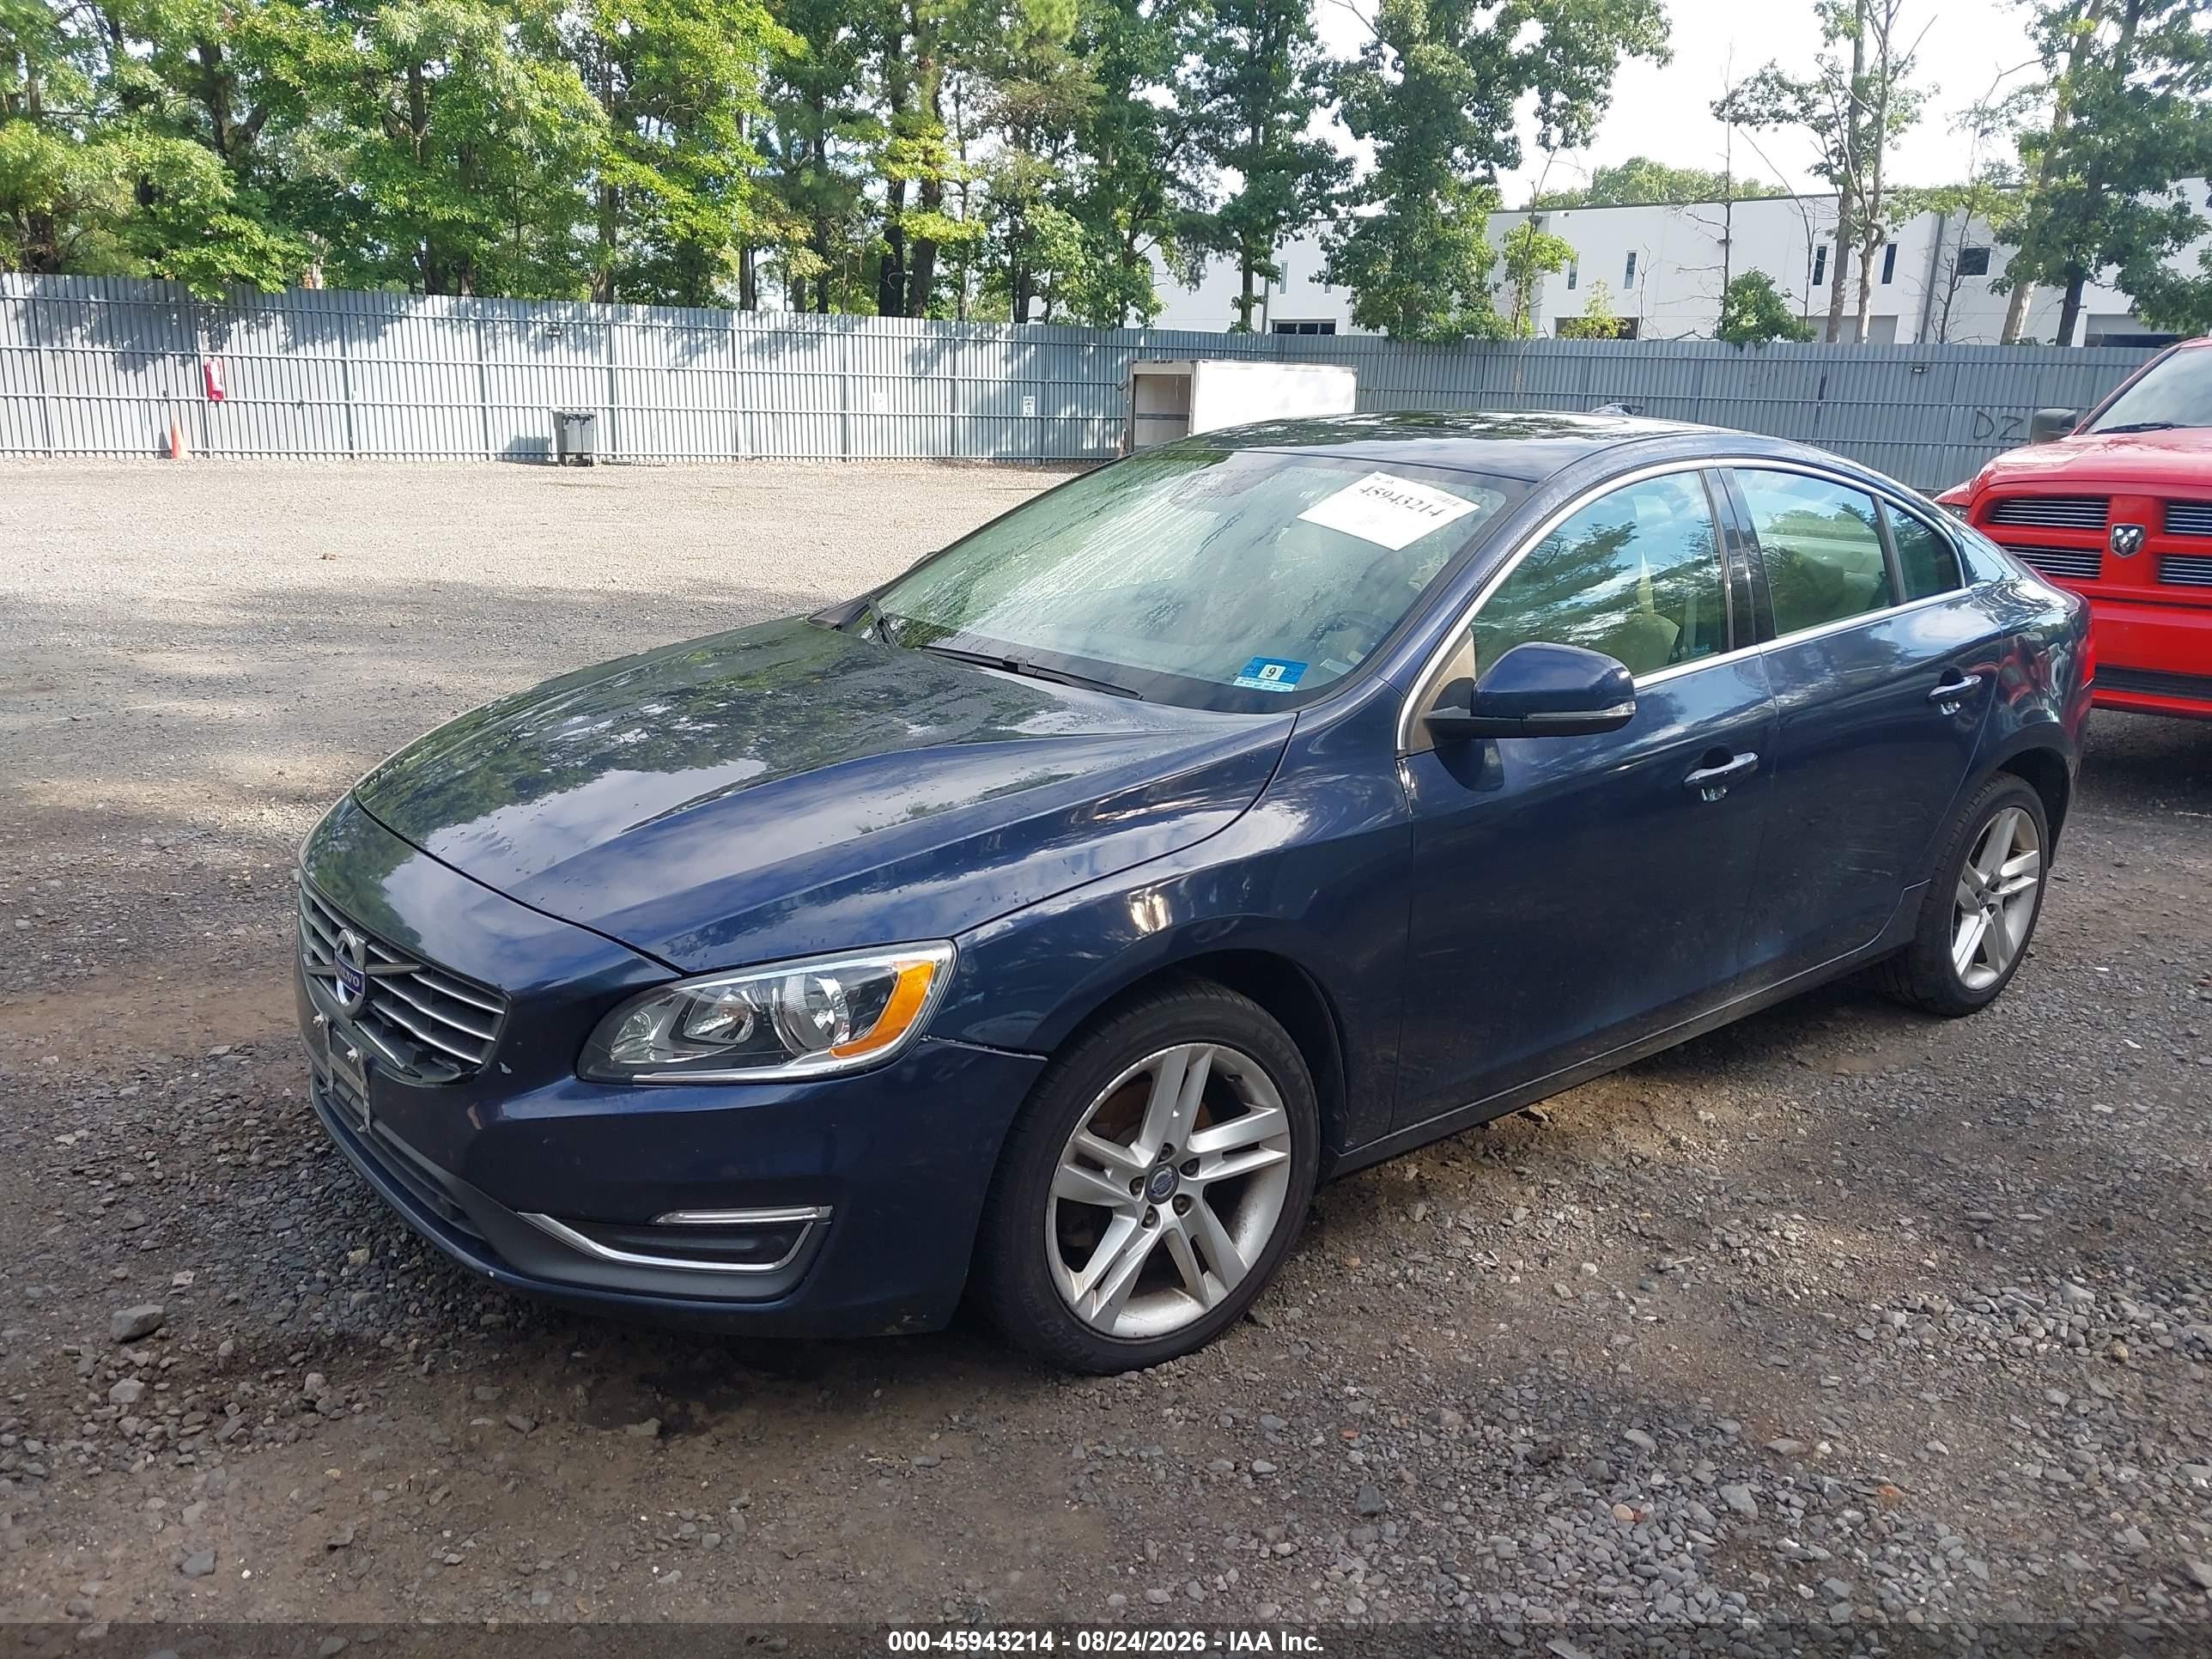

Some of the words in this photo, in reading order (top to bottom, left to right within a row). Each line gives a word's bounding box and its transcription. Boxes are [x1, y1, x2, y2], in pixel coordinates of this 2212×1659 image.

[1360, 485, 1446, 517] 45943214
[1266, 666, 1277, 678] 9
[337, 964, 360, 988] OLVO
